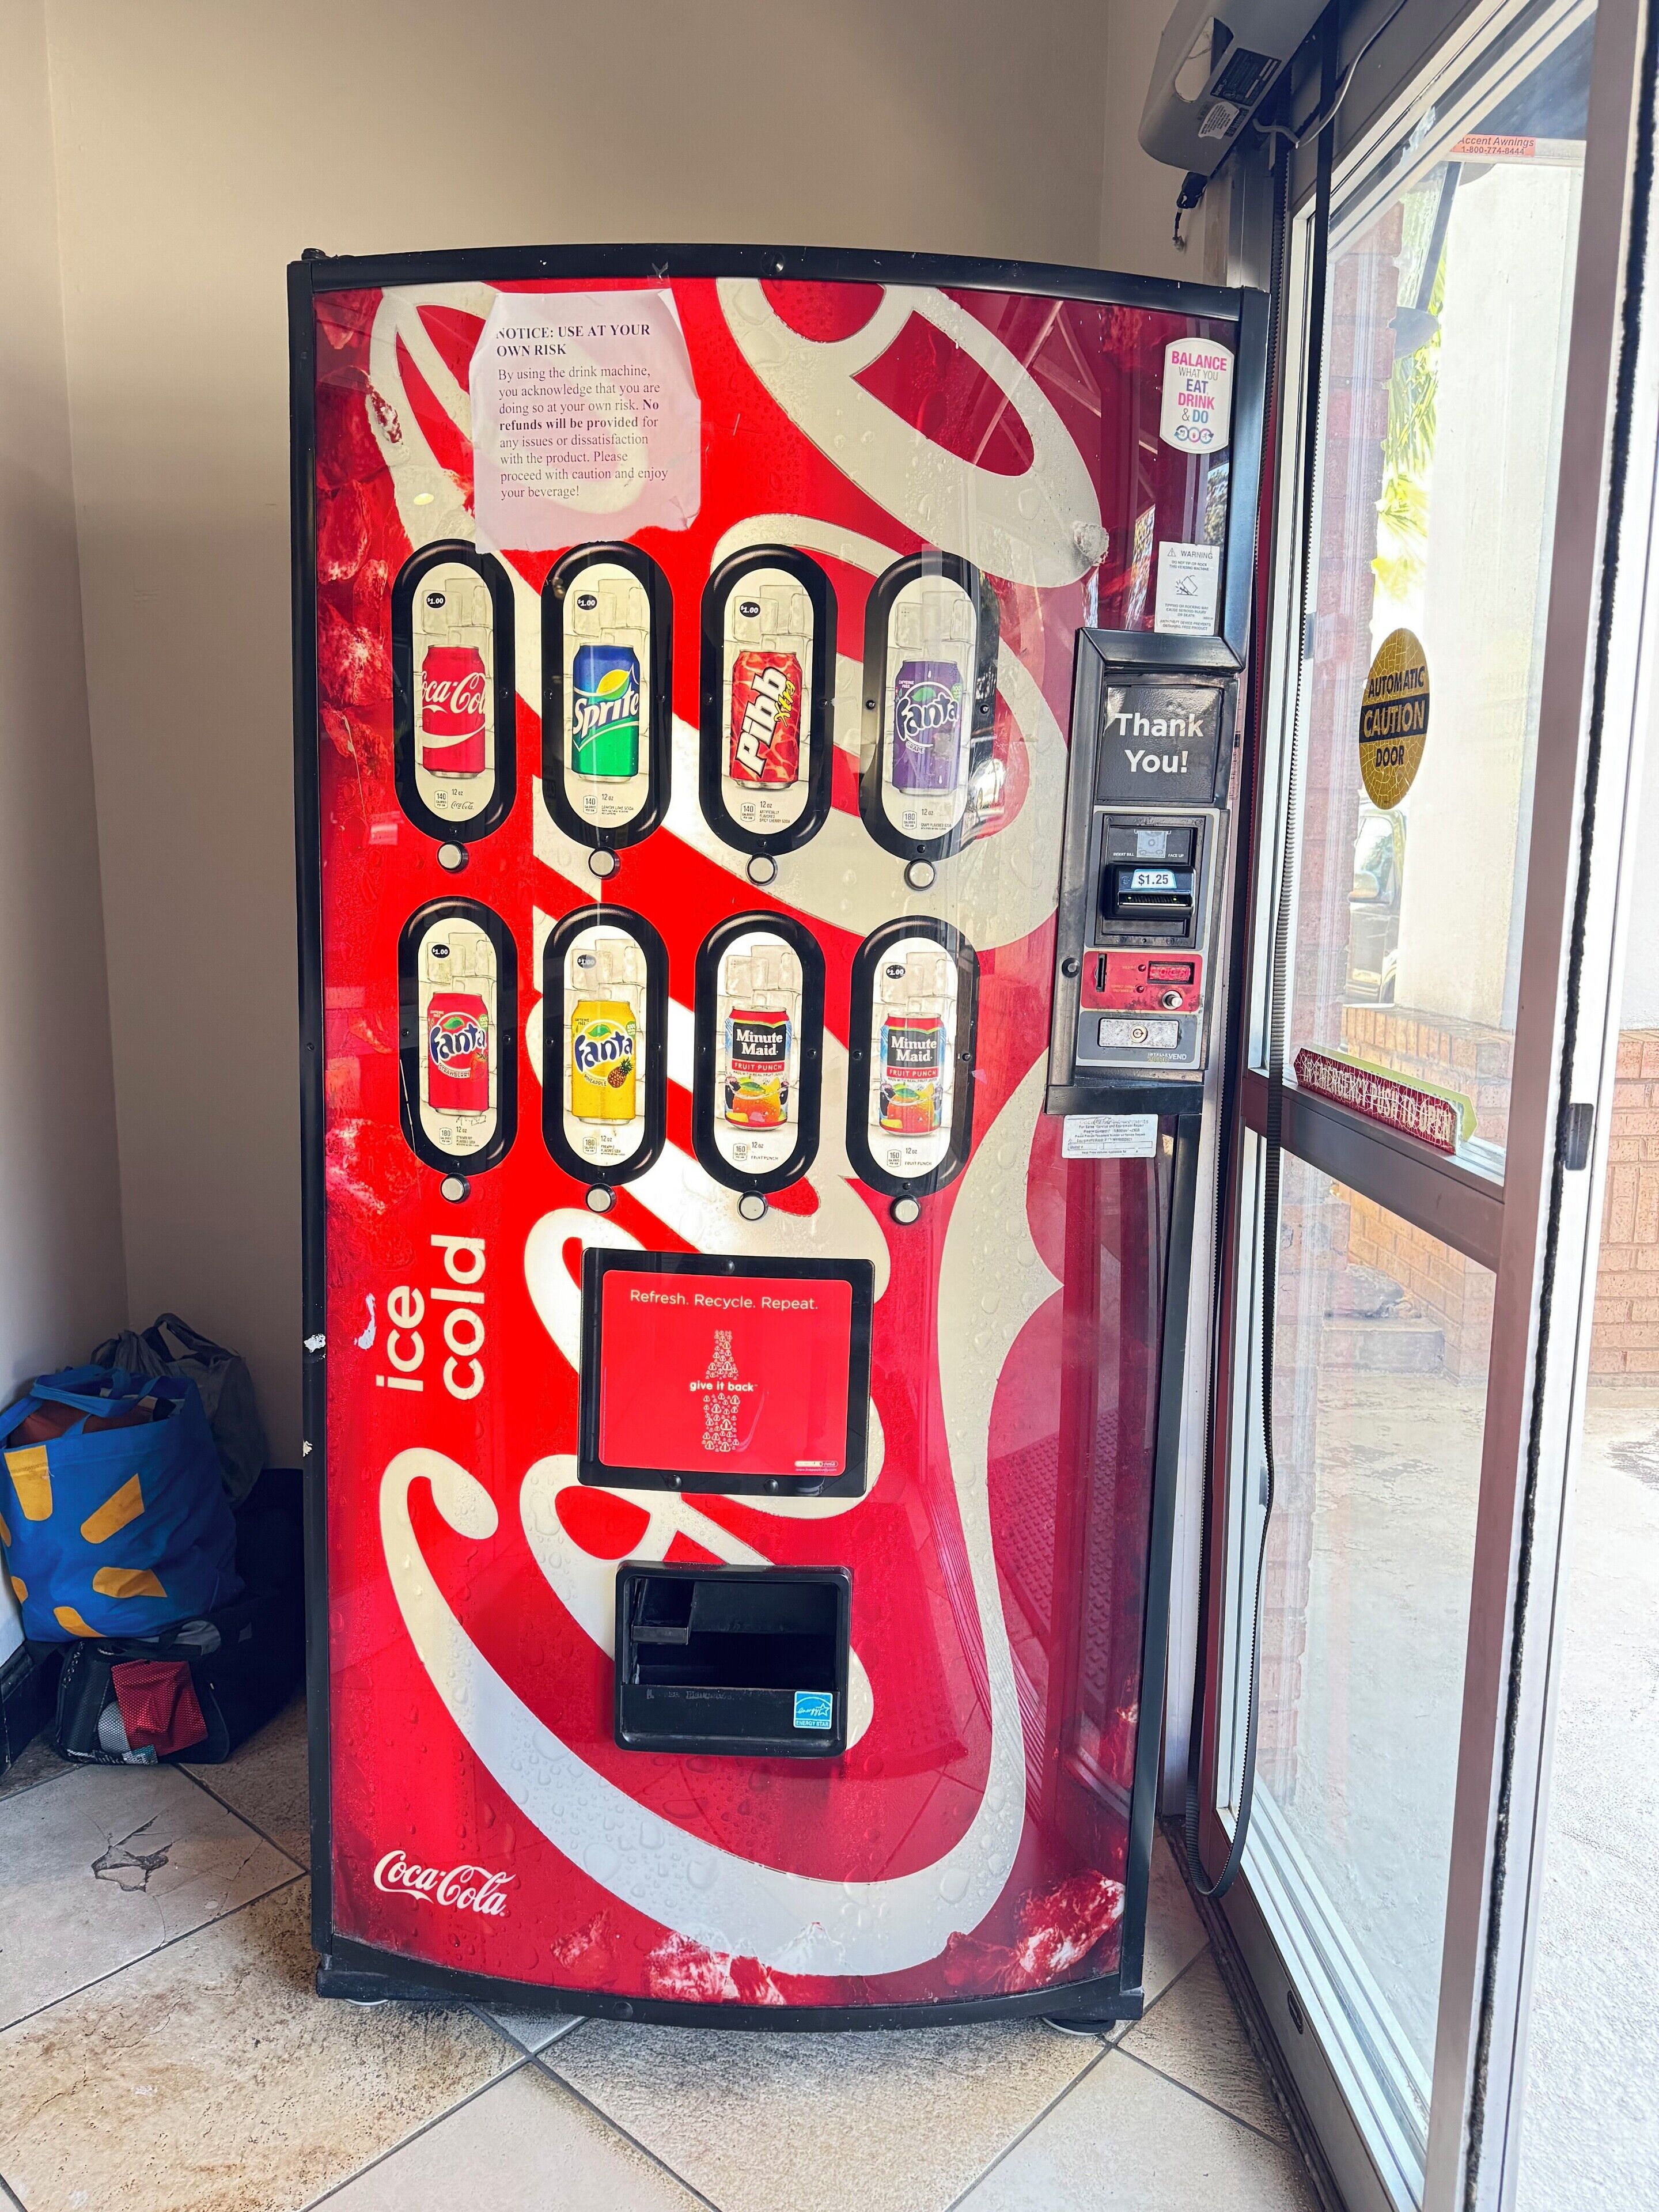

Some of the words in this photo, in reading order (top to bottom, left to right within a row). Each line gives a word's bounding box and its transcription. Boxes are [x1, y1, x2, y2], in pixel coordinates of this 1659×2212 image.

[1462, 146, 1524, 154] 1-800-774-8444
[1493, 138, 1534, 148] Awnings
[496, 327, 554, 339] NOTICE:
[558, 326, 583, 337] USE
[588, 325, 605, 336] AT
[610, 324, 650, 336] YOUR
[497, 346, 530, 357] OWN
[534, 344, 567, 355] RISK
[1172, 351, 1227, 371] BALANCE
[498, 369, 514, 382] By
[517, 369, 546, 381] using
[548, 368, 566, 378] the
[569, 366, 597, 378] drink
[600, 365, 651, 378] machine,
[1179, 367, 1200, 378] WHAT
[1203, 370, 1218, 381] YOU
[499, 387, 518, 399] you
[521, 384, 593, 397] acknowledge
[596, 383, 616, 394] that
[619, 384, 640, 396] you
[643, 384, 660, 393] are
[499, 403, 529, 416] doing
[532, 405, 544, 414] so
[547, 403, 557, 412] at
[560, 402, 586, 414] your
[588, 402, 611, 411] own
[615, 399, 639, 410] risk.
[642, 399, 659, 410] No
[1178, 392, 1215, 410] DRINK
[1181, 408, 1190, 421] &
[1192, 410, 1209, 423] DO
[499, 419, 542, 431] refunds
[546, 418, 567, 429] will
[570, 418, 583, 429] be
[586, 416, 638, 430] provided
[642, 416, 659, 427] for
[500, 439, 518, 450] any
[522, 436, 554, 446] issues
[556, 438, 568, 446] or
[571, 434, 648, 446] dissatisfaction
[500, 453, 523, 465] with
[527, 453, 543, 463] the
[546, 452, 590, 465] product.
[593, 451, 628, 462] Please
[501, 469, 542, 482] proceed
[545, 469, 569, 480] with
[572, 468, 611, 479] caution
[615, 468, 635, 479] and
[638, 468, 668, 482] enjoy
[501, 487, 525, 501] your
[528, 486, 579, 499] beverage!
[1181, 550, 1213, 559] WARNING
[578, 599, 595, 607] $1.00
[740, 605, 759, 613] $1.00
[1368, 665, 1425, 698] AUTOMATIC
[573, 681, 639, 739] Sprite
[735, 666, 787, 778] Pibb
[1116, 713, 1204, 737] Thank
[1363, 700, 1426, 738] CAUTION
[1124, 749, 1188, 774] You!
[1375, 745, 1405, 768] DOOR
[1138, 874, 1168, 885] $1.25
[736, 1029, 783, 1043] Minute
[891, 1036, 937, 1050] Minute
[734, 1062, 755, 1070] FRUIT
[1370, 1082, 1399, 1119] PUSH
[1419, 1102, 1451, 1142] OPEN
[630, 1289, 689, 1306] Refresh.
[694, 1294, 756, 1309] Recycle.
[762, 1297, 818, 1312] Repeat.
[431, 1234, 486, 1400] cold
[376, 1285, 425, 1392] ice
[690, 1381, 713, 1392] give
[716, 1381, 724, 1391] it
[728, 1381, 754, 1392] back
[373, 1850, 516, 1917] Coca-Cola
